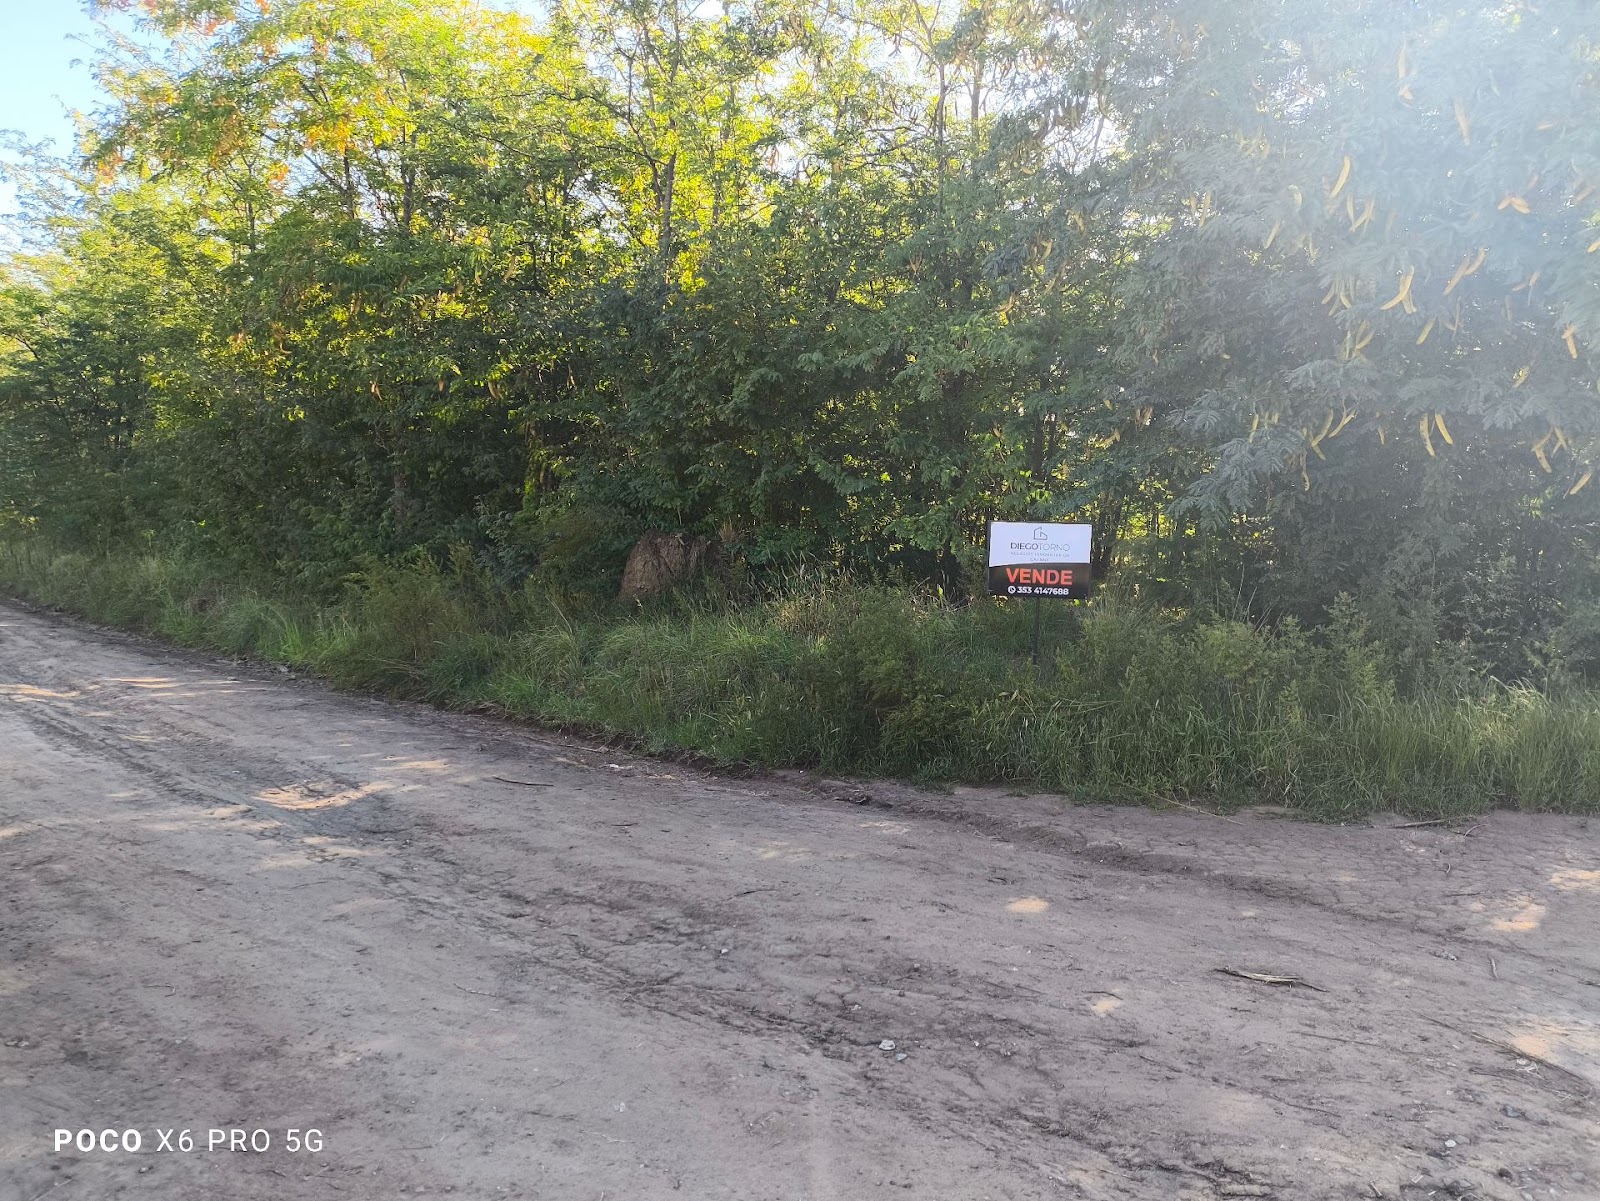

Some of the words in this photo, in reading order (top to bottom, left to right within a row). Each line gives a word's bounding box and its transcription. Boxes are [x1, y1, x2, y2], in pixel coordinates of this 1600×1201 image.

[1010, 542, 1071, 552] DIEGOTORNO
[1005, 567, 1073, 586] VENDE
[1017, 586, 1032, 594] 353
[1033, 586, 1069, 595] 4147688
